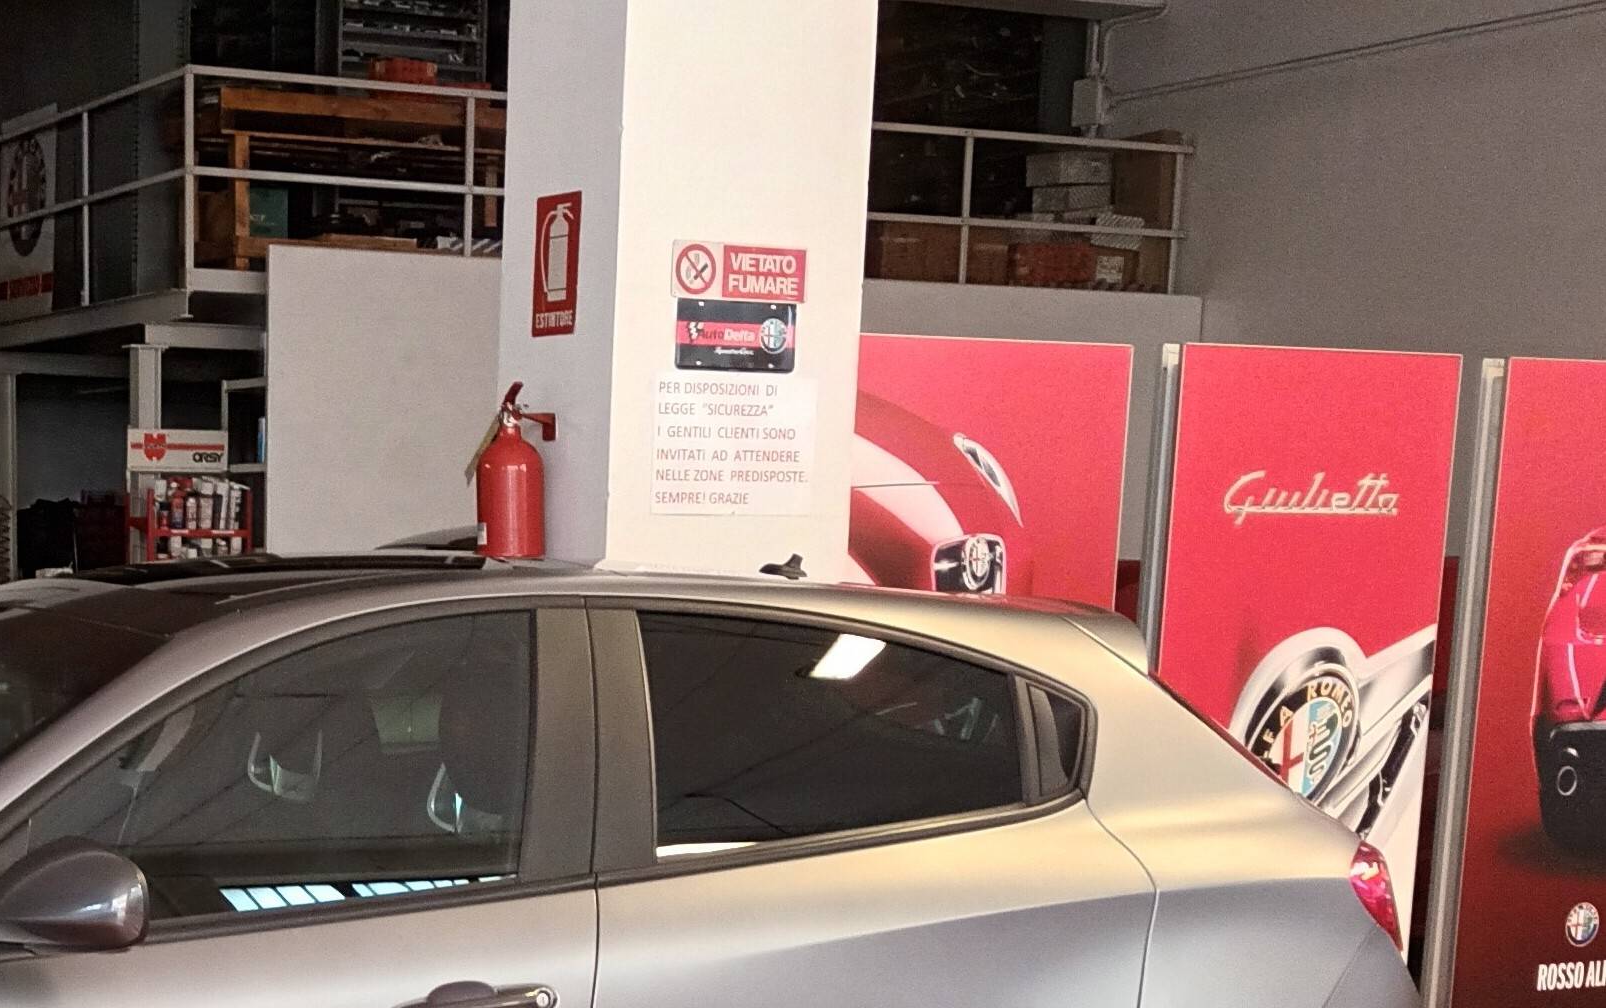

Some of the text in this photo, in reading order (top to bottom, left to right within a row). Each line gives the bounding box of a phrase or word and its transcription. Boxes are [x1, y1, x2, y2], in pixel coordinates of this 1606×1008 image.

[730, 252, 797, 275] VIETATO
[728, 274, 799, 296] FUMARE
[535, 310, 573, 329] ESTINTORE
[658, 381, 778, 397] PER DISPOSIZIONI DI
[658, 402, 696, 416] LEGGE
[657, 425, 796, 440] I GENTILI CLIENTI SONO
[192, 452, 224, 463] ORSY
[656, 449, 801, 463] INVITATI AD ATTENDERE
[655, 469, 809, 483] NELLE ZONE PREDISPOSTE.
[709, 492, 750, 505] GRAZIE
[1224, 470, 1400, 526] Giulietta
[1306, 680, 1353, 729] ROMEO
[1536, 961, 1585, 991] ROSSO
